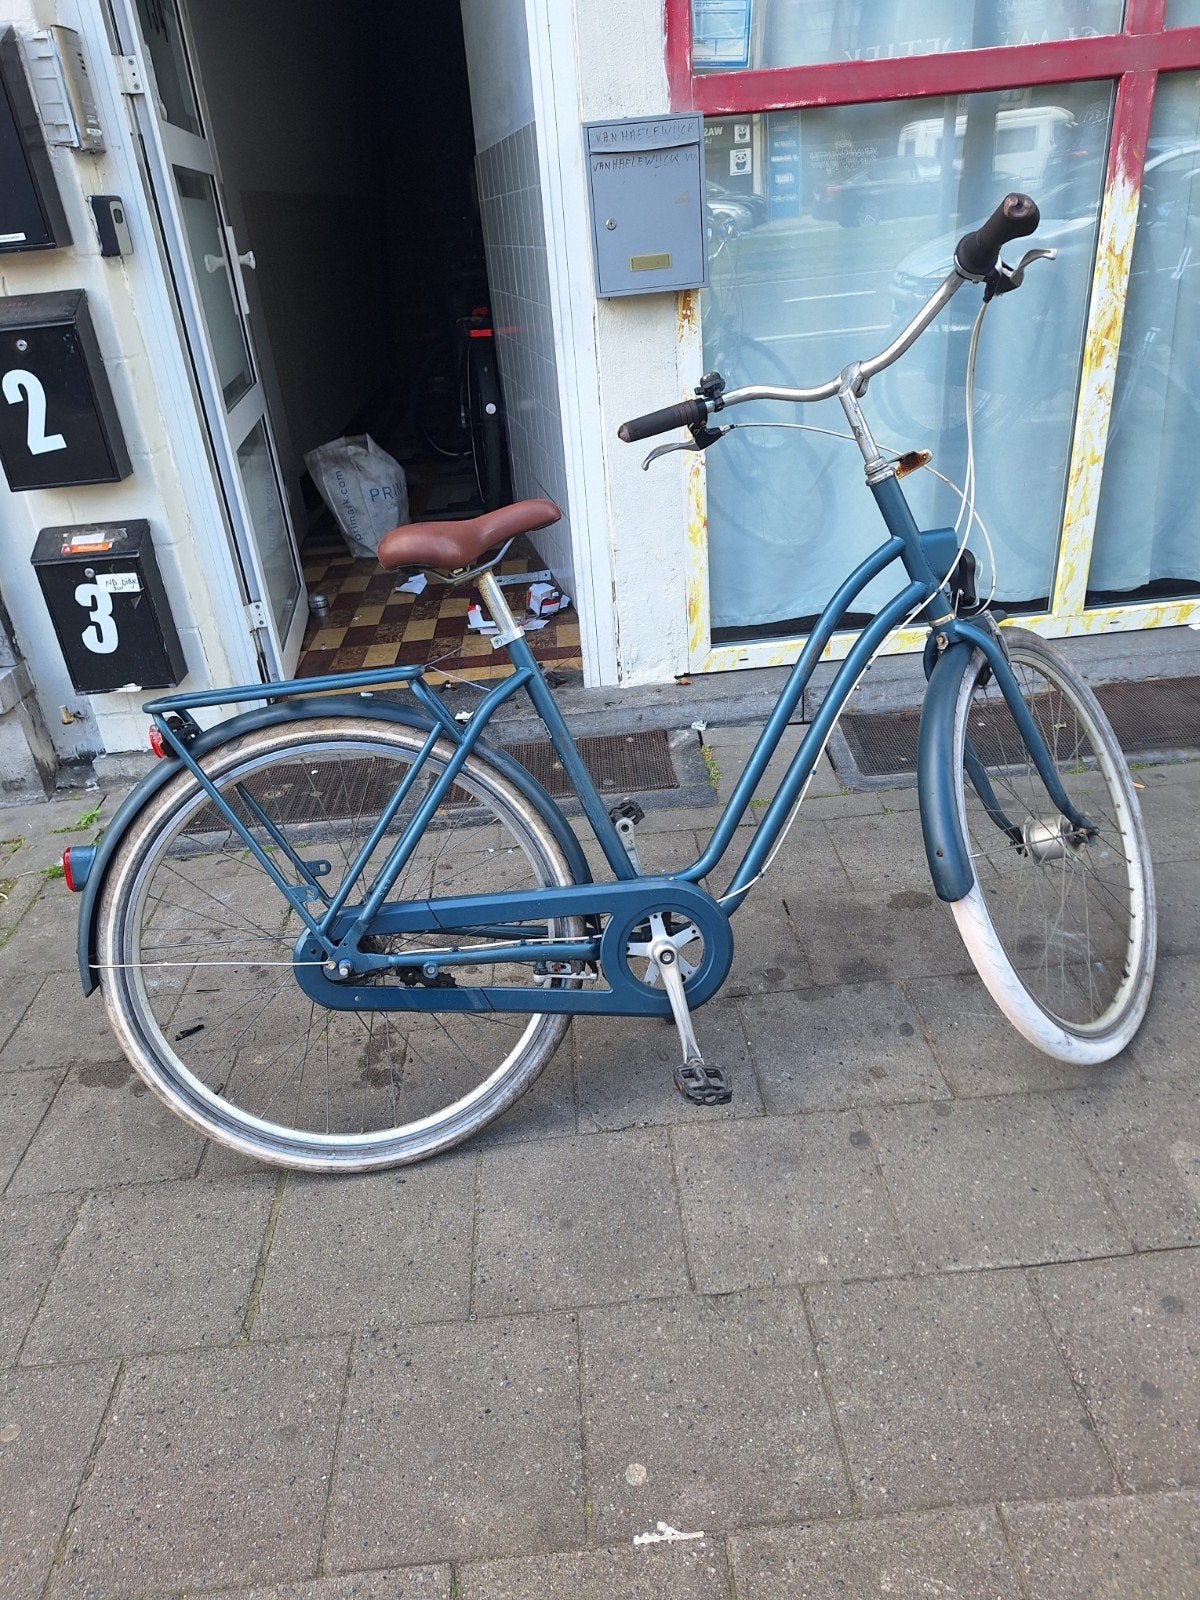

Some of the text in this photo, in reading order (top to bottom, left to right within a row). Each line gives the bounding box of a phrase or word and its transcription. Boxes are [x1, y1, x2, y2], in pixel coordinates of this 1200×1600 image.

[2, 369, 67, 455] 2
[335, 470, 364, 541] primark.com
[75, 583, 119, 654] 3
